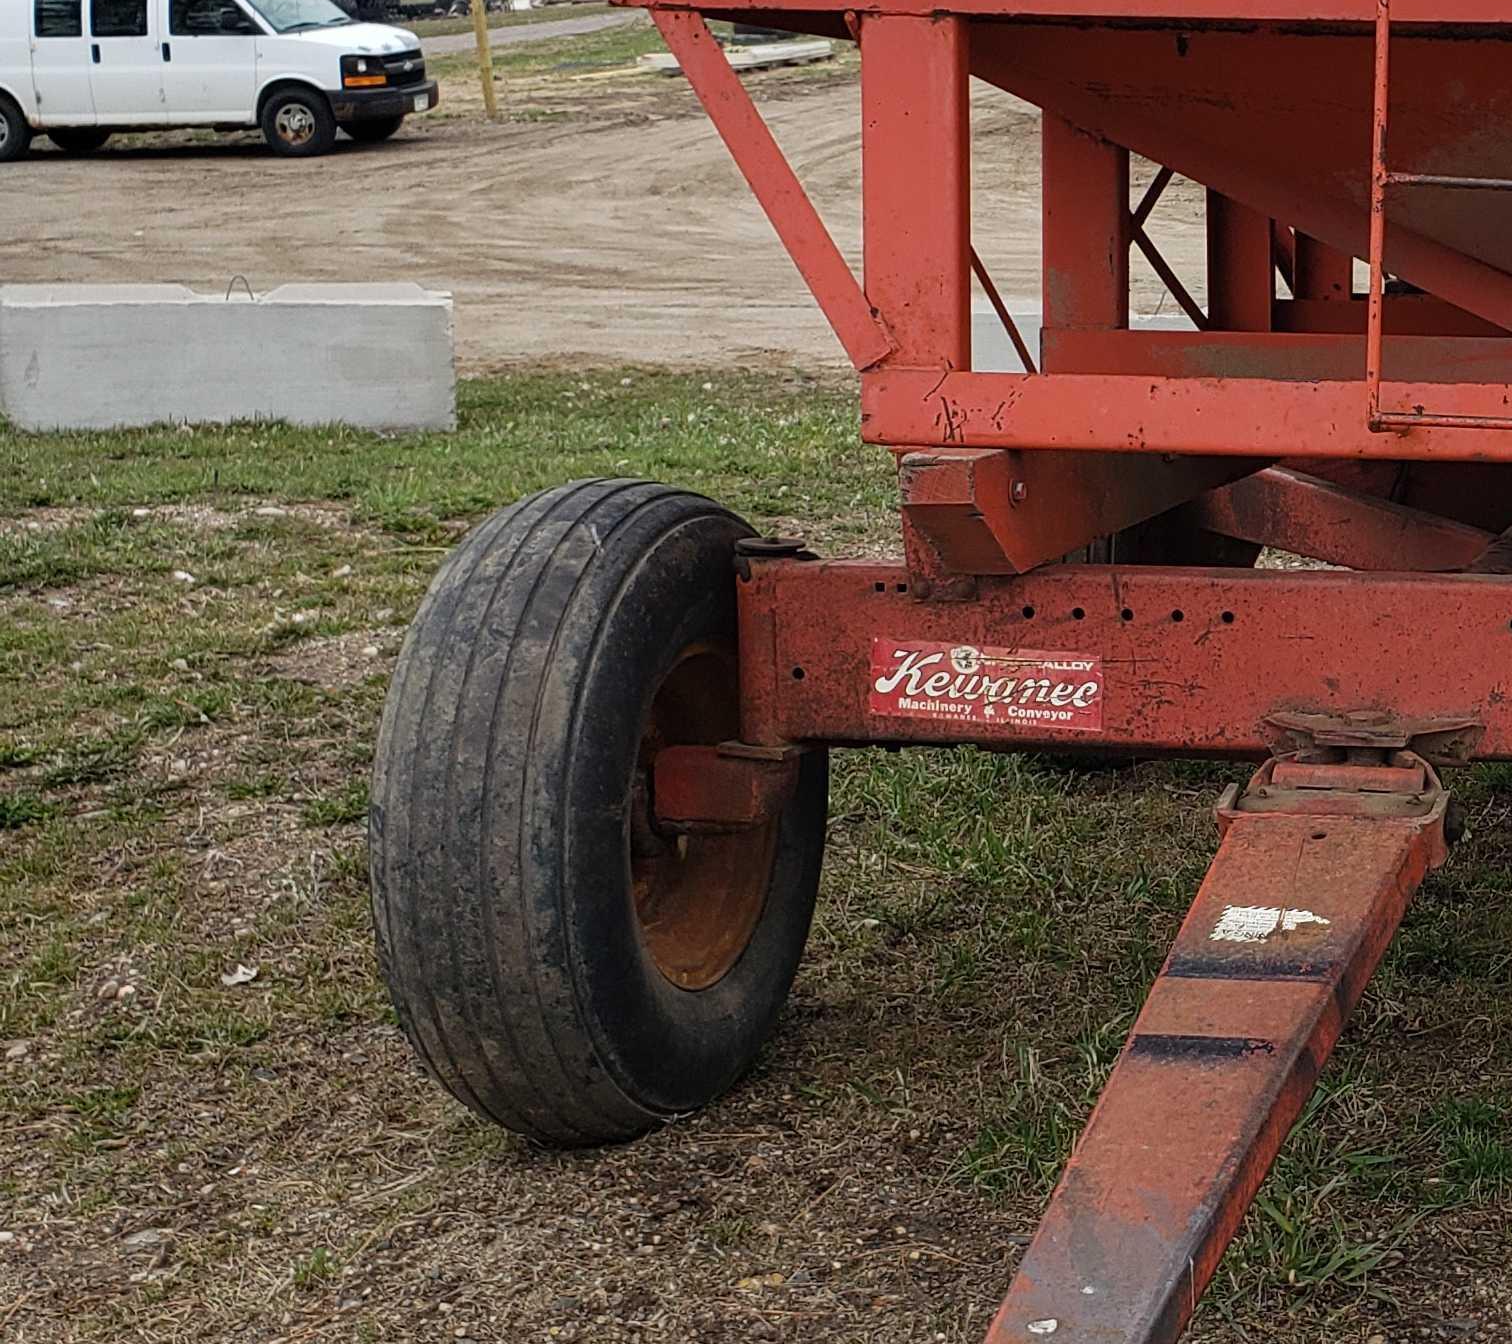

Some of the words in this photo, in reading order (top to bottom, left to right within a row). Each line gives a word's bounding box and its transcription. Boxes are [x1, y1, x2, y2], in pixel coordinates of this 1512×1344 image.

[898, 697, 972, 714] Machinery
[984, 704, 995, 716] &
[1007, 705, 1073, 721] Conveyor
